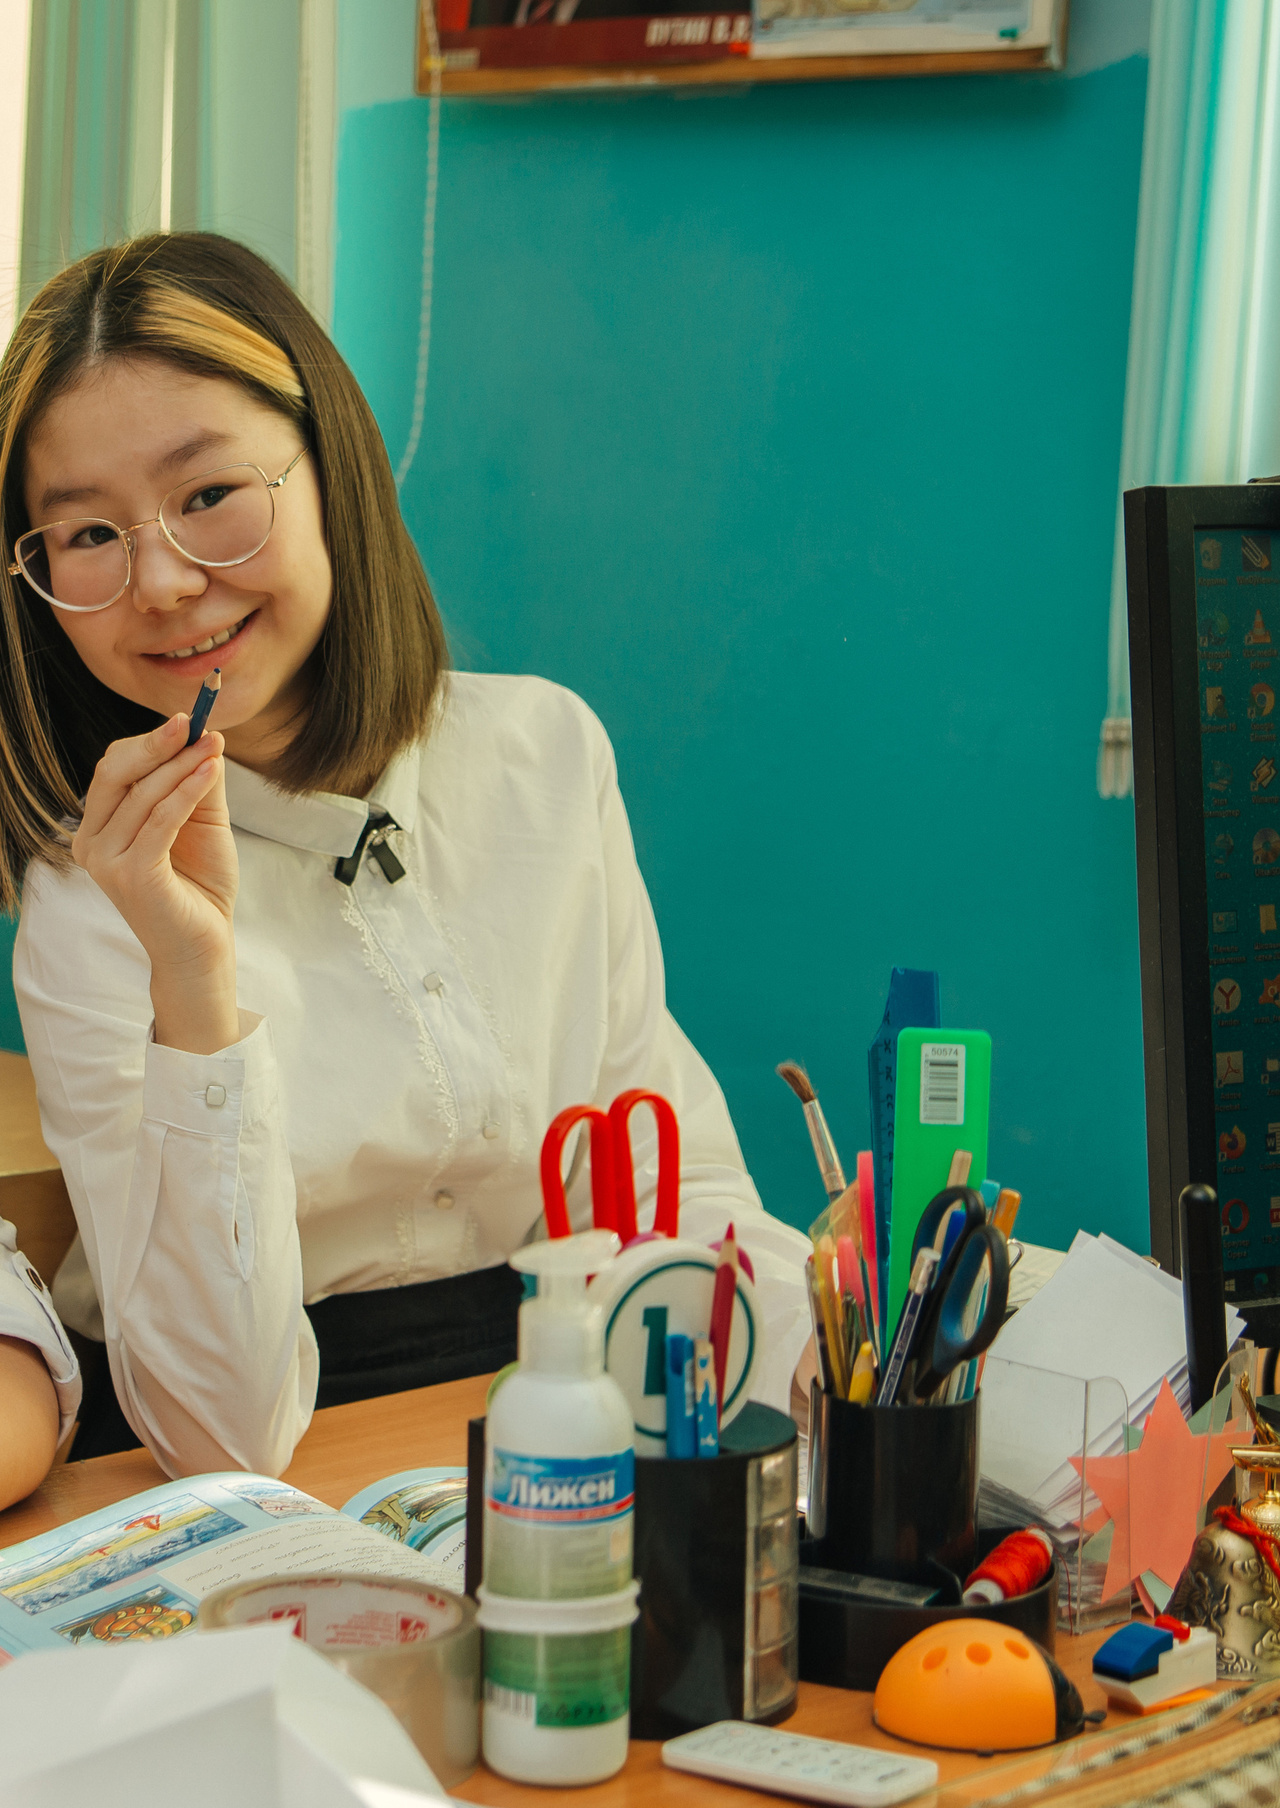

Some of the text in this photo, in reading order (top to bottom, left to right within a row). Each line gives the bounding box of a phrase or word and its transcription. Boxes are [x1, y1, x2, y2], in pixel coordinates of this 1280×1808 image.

[931, 1047, 959, 1056] 50574
[642, 1307, 667, 1396] 1
[506, 1473, 616, 1507] Лижен
